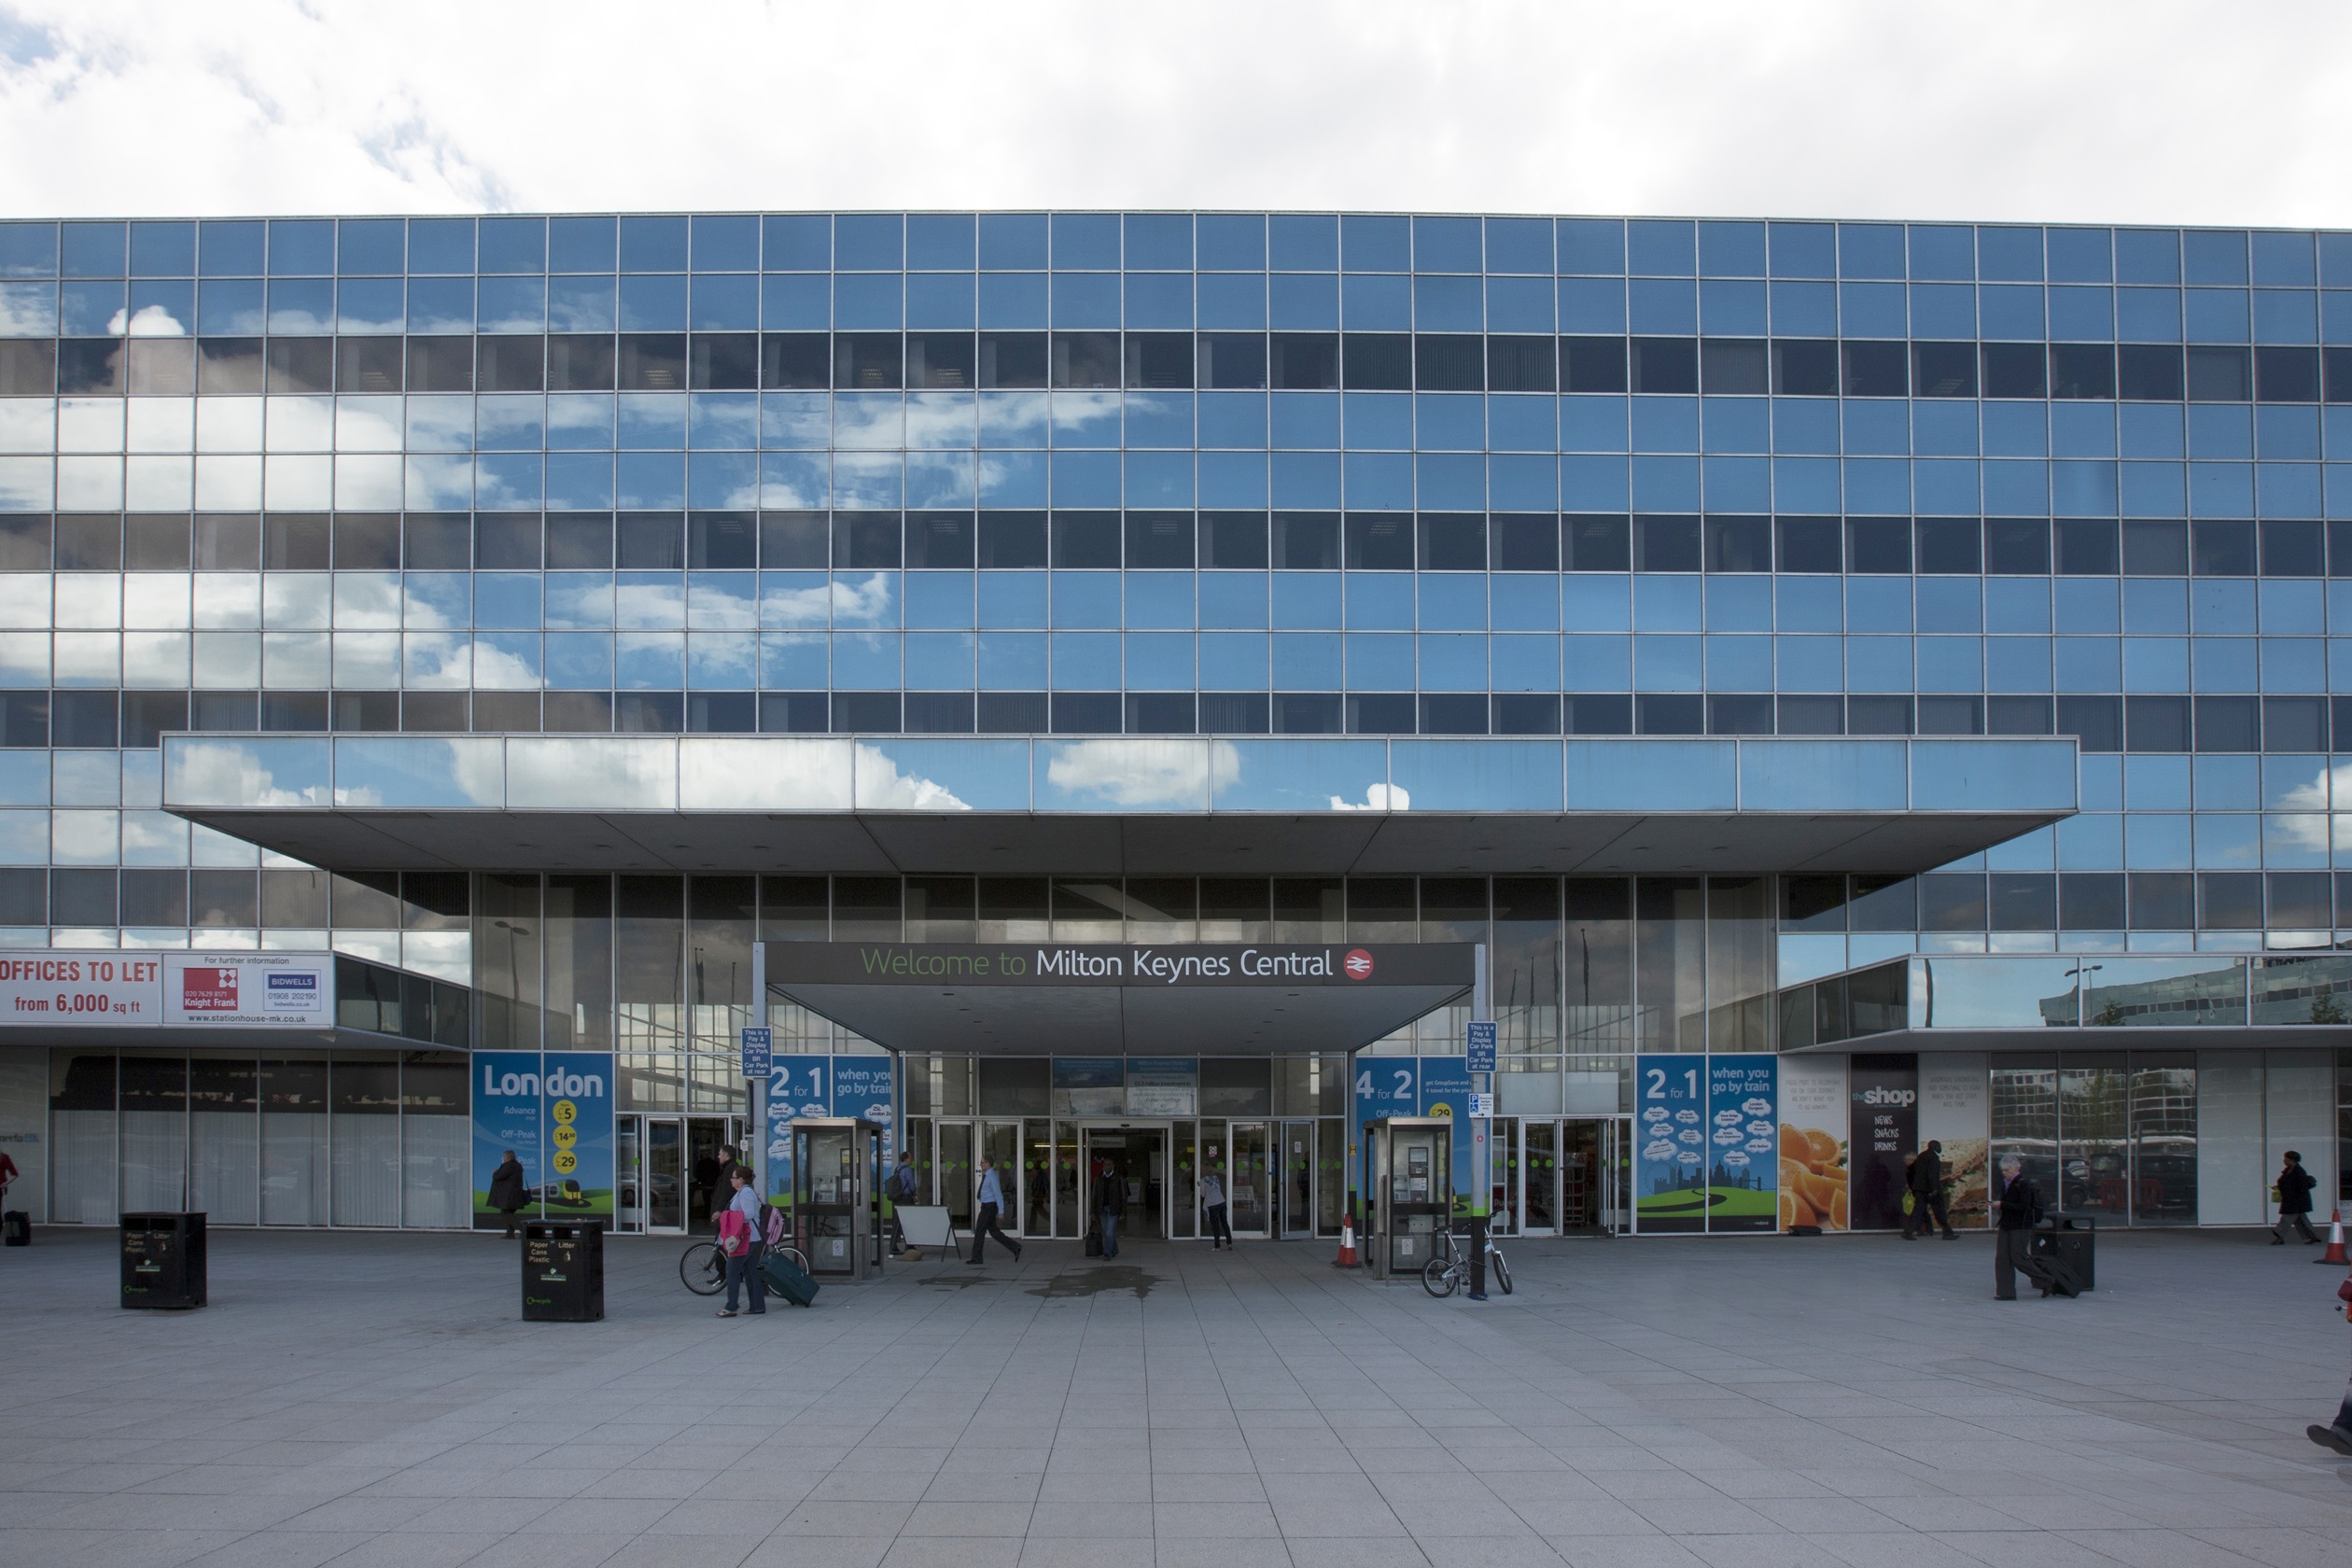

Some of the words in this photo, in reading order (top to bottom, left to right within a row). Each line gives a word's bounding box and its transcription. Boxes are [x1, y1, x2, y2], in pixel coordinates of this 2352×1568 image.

[246, 957, 289, 965] information
[861, 948, 989, 976] Welcome
[998, 952, 1027, 976] to
[1037, 949, 1122, 976] Milton
[1134, 950, 1230, 984] Keynes
[1240, 949, 1333, 976] Central
[0, 960, 80, 981] OFFICES
[88, 961, 114, 982] TO
[122, 962, 158, 982] LET
[15, 996, 49, 1011] from
[56, 994, 109, 1015] 6,000
[113, 1003, 126, 1015] sq
[131, 1001, 141, 1013] ft
[185, 998, 212, 1008] Knight
[214, 999, 236, 1007] Frank
[189, 1015, 306, 1023] www.stationhouse-mk.co.uk
[837, 1069, 869, 1080] when
[1712, 1068, 1743, 1079] when
[1747, 1070, 1769, 1081] you
[484, 1065, 603, 1098] London
[771, 1066, 790, 1096] 2
[793, 1085, 808, 1097] for
[808, 1067, 820, 1097] 1
[1356, 1071, 1375, 1099] 4
[1378, 1088, 1391, 1099] for
[1393, 1070, 1412, 1099] 2
[1646, 1069, 1666, 1099] 2
[1670, 1087, 1684, 1099] for
[1684, 1069, 1696, 1099] 1
[837, 1085, 851, 1097] go
[853, 1083, 868, 1097] by
[1712, 1083, 1726, 1095] go
[1729, 1081, 1743, 1095] by
[1743, 1081, 1770, 1092] train
[504, 1106, 536, 1114] Advance
[558, 1108, 571, 1120] £5
[1874, 1115, 1893, 1126] NEWS
[501, 1130, 537, 1139] Off-Peak
[1874, 1128, 1899, 1139] SNACKS
[1874, 1141, 1897, 1152] DRINKS
[555, 1156, 575, 1167] £29
